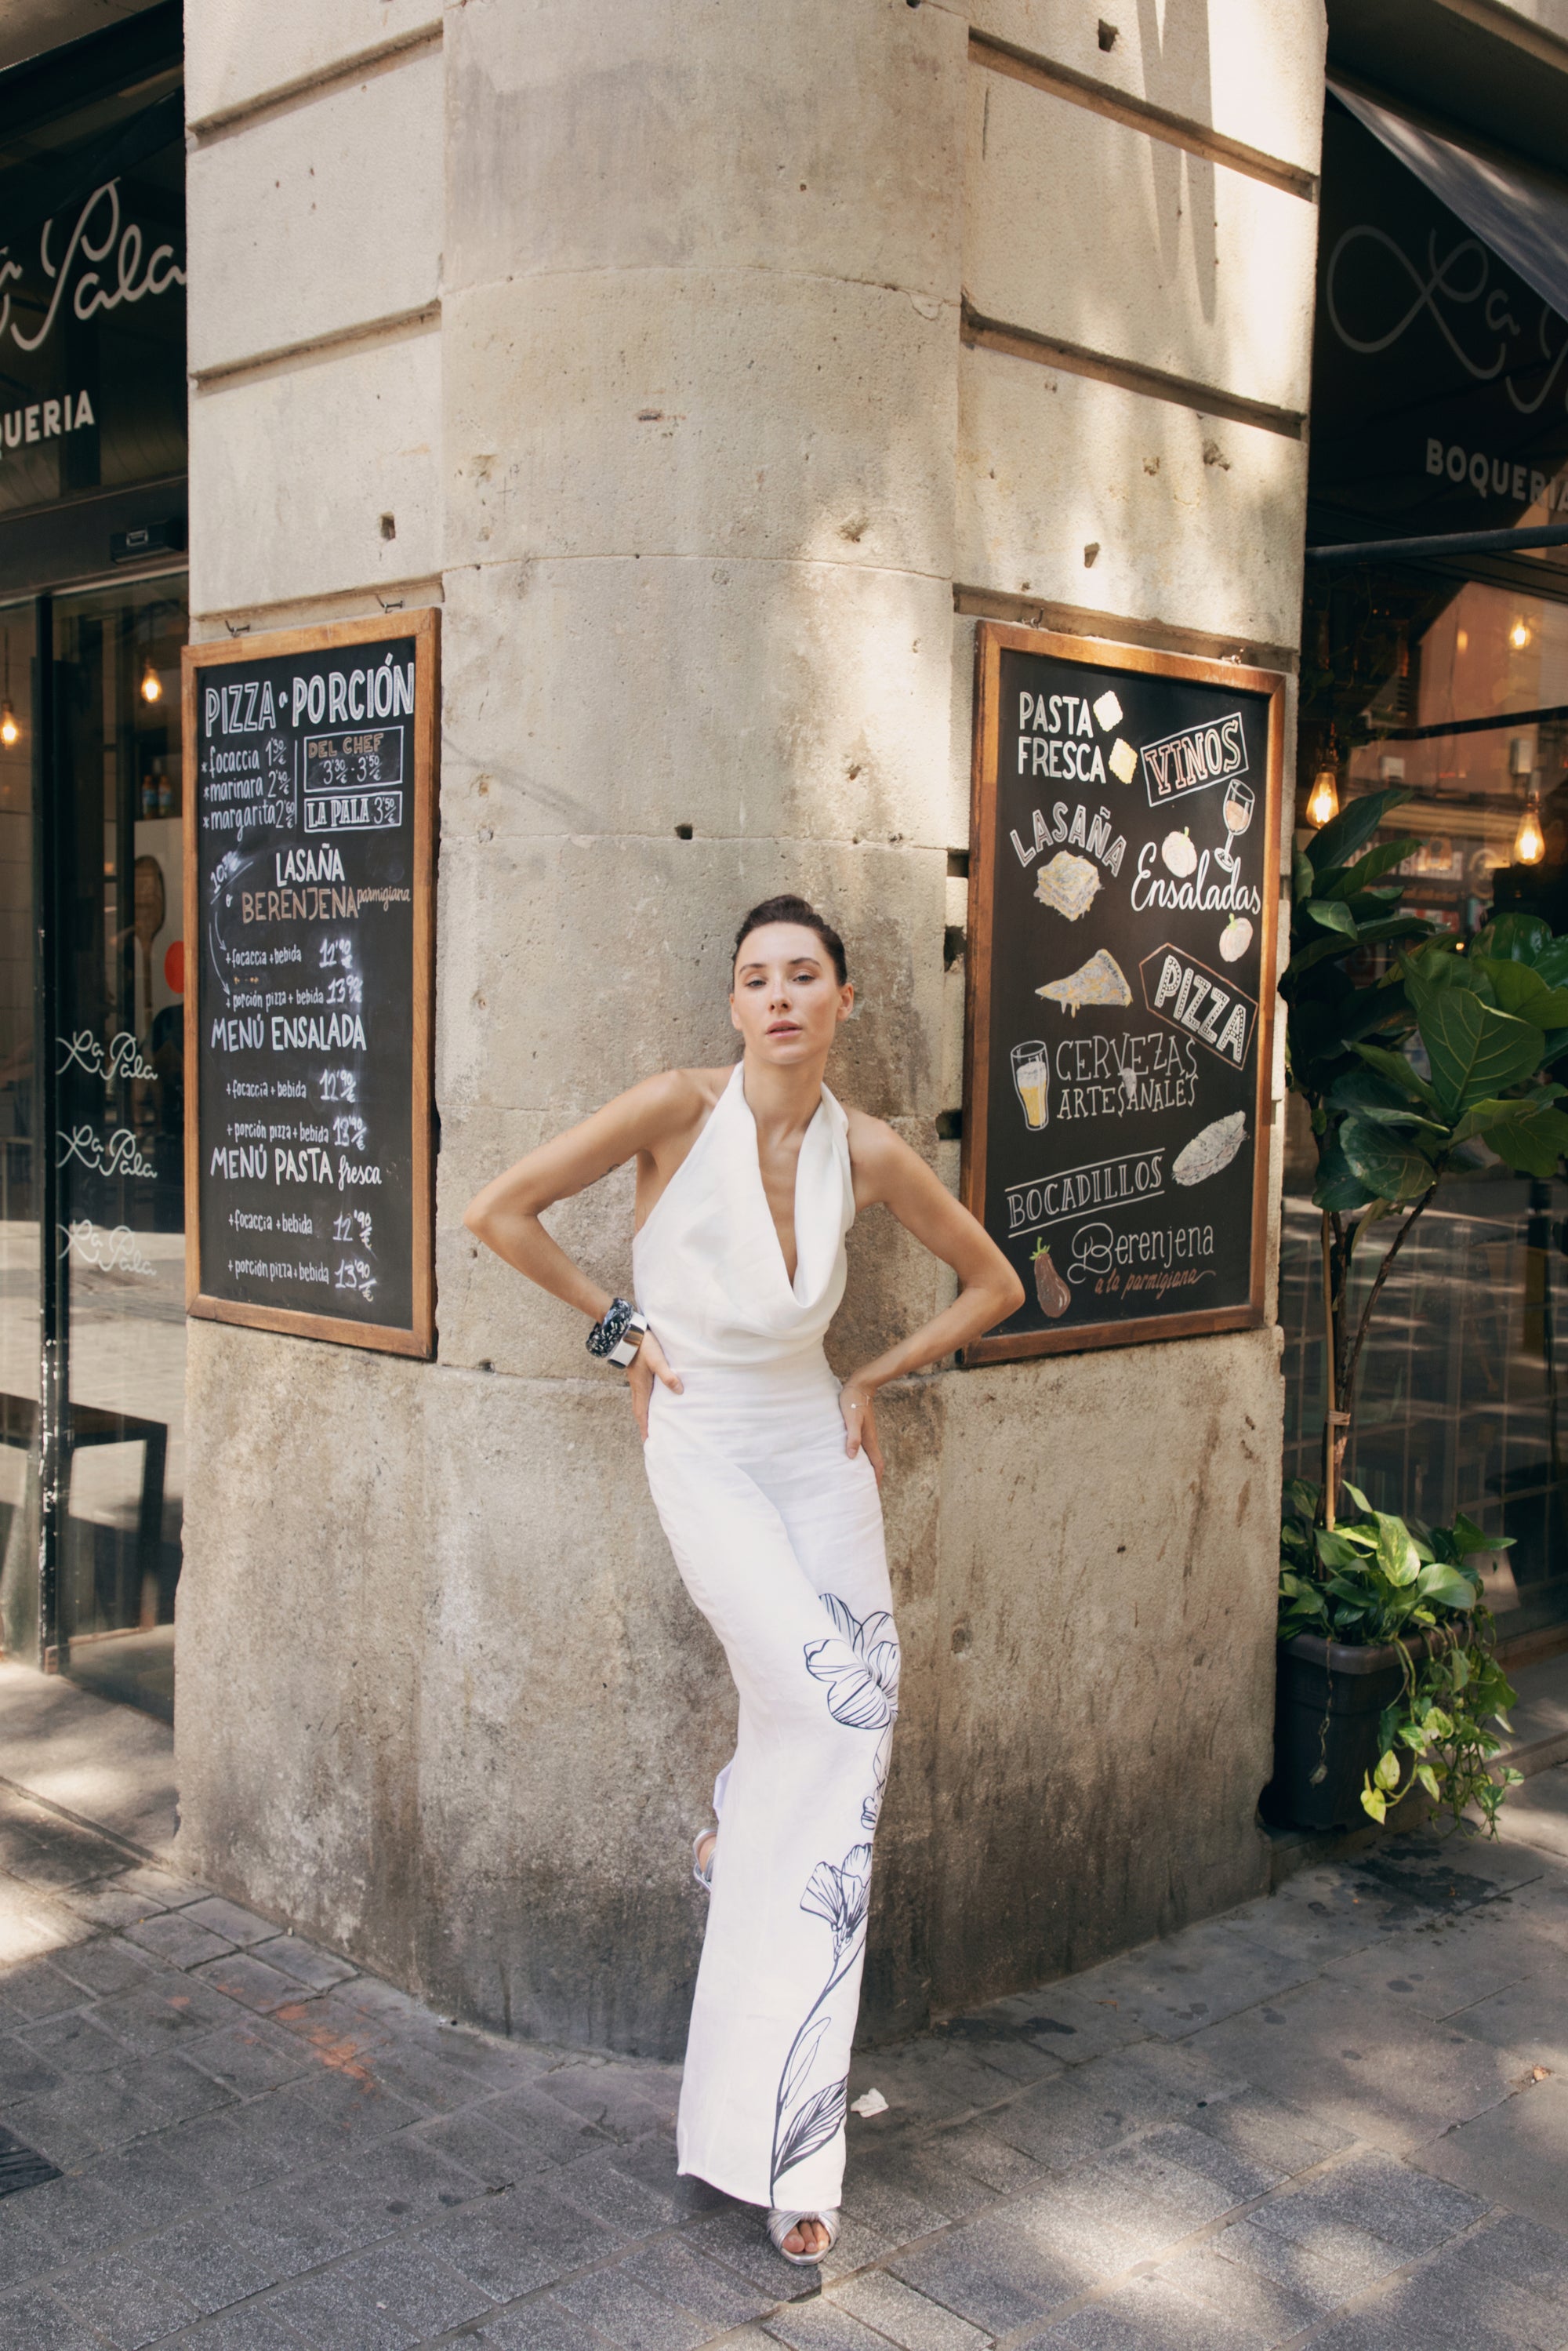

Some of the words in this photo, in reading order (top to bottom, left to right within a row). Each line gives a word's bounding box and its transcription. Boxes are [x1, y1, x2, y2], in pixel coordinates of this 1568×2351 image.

[0, 391, 95, 456] UERIA
[205, 681, 276, 737] PIZZA
[292, 652, 415, 728] PORCIÓN
[1019, 691, 1094, 738] PASTA
[209, 745, 260, 779] focaccia
[308, 739, 338, 759] DEL
[342, 732, 384, 754] CHEF
[1018, 736, 1106, 784] FRESCA
[1145, 719, 1242, 796] VINOS
[209, 777, 264, 802] marinara
[307, 801, 327, 828] LA
[330, 798, 370, 827] PALA
[210, 798, 276, 842] margarita
[1009, 801, 1127, 878] LASAÑA
[276, 843, 345, 888] LASAÑA
[1131, 841, 1261, 915] Ensaladas
[241, 885, 359, 925] BERENJENA
[357, 885, 412, 912] parmigiana
[233, 990, 263, 1012] porción
[265, 990, 287, 1012] pizza
[296, 987, 324, 1006] bebida
[1154, 954, 1247, 1063] PIZZA
[211, 1013, 264, 1052] MENÚ
[271, 1012, 367, 1051] ENSALADA
[99, 1032, 158, 1081] Pala
[1055, 1032, 1197, 1081] CERVEZAS
[1057, 1073, 1199, 1121] ARTESANALES
[99, 1128, 158, 1179] Pala
[234, 1120, 267, 1143] porción
[269, 1125, 291, 1143] pizza
[299, 1121, 329, 1143] bebida
[209, 1143, 268, 1180] MENÚ
[274, 1147, 334, 1186] PASTA
[338, 1154, 383, 1191] fresca
[1007, 1155, 1163, 1230] BOCADILLOS
[234, 1259, 268, 1281] porción
[270, 1261, 293, 1282] pizza
[299, 1261, 330, 1285] bebida
[1067, 1222, 1214, 1285] Berenjena
[1094, 1277, 1105, 1294] a
[1105, 1267, 1120, 1294] la
[1120, 1267, 1217, 1300] parmigiana
